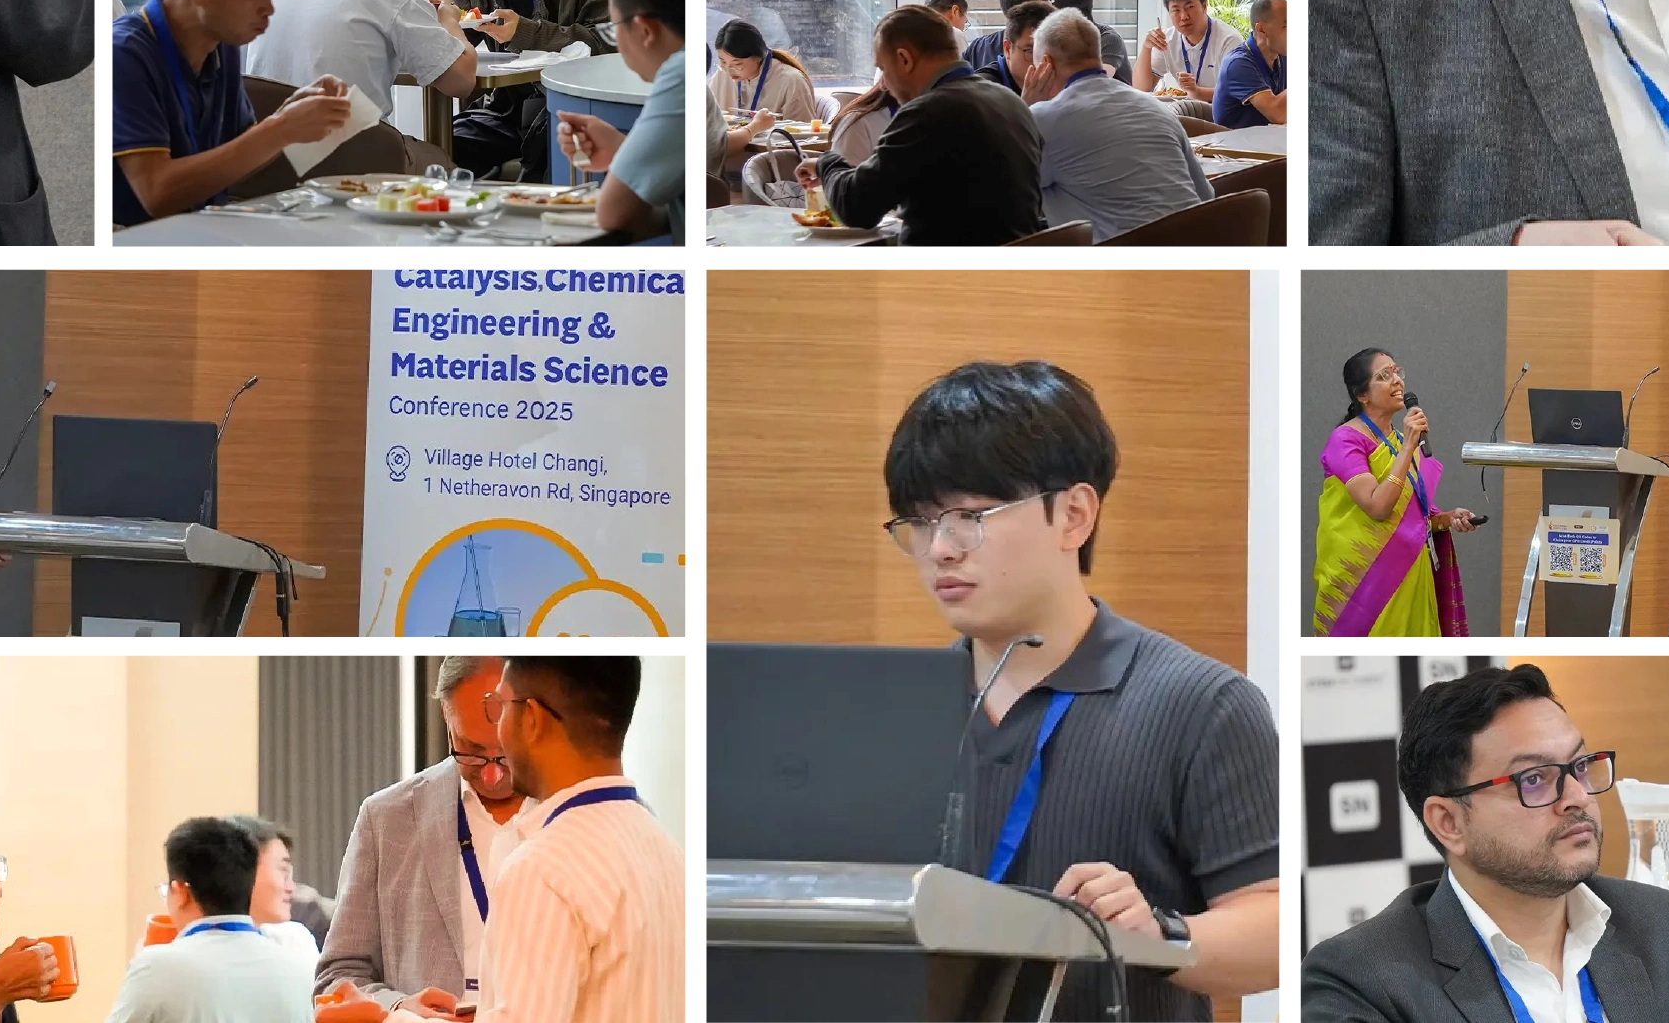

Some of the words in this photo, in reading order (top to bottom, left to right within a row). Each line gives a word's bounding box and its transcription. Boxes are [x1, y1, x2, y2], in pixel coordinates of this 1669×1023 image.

[392, 308, 582, 344] Engineering
[588, 312, 616, 339] &
[391, 352, 536, 382] Materials
[544, 356, 668, 387] Science
[389, 395, 508, 419] Conference
[516, 400, 573, 421] 2025
[424, 448, 483, 471] Village
[489, 451, 537, 469] Hotel
[543, 453, 607, 477] Changi,
[424, 477, 431, 492] 1
[440, 477, 540, 498] Netheravon
[547, 483, 573, 503] Rd,
[579, 484, 671, 508] Singapore
